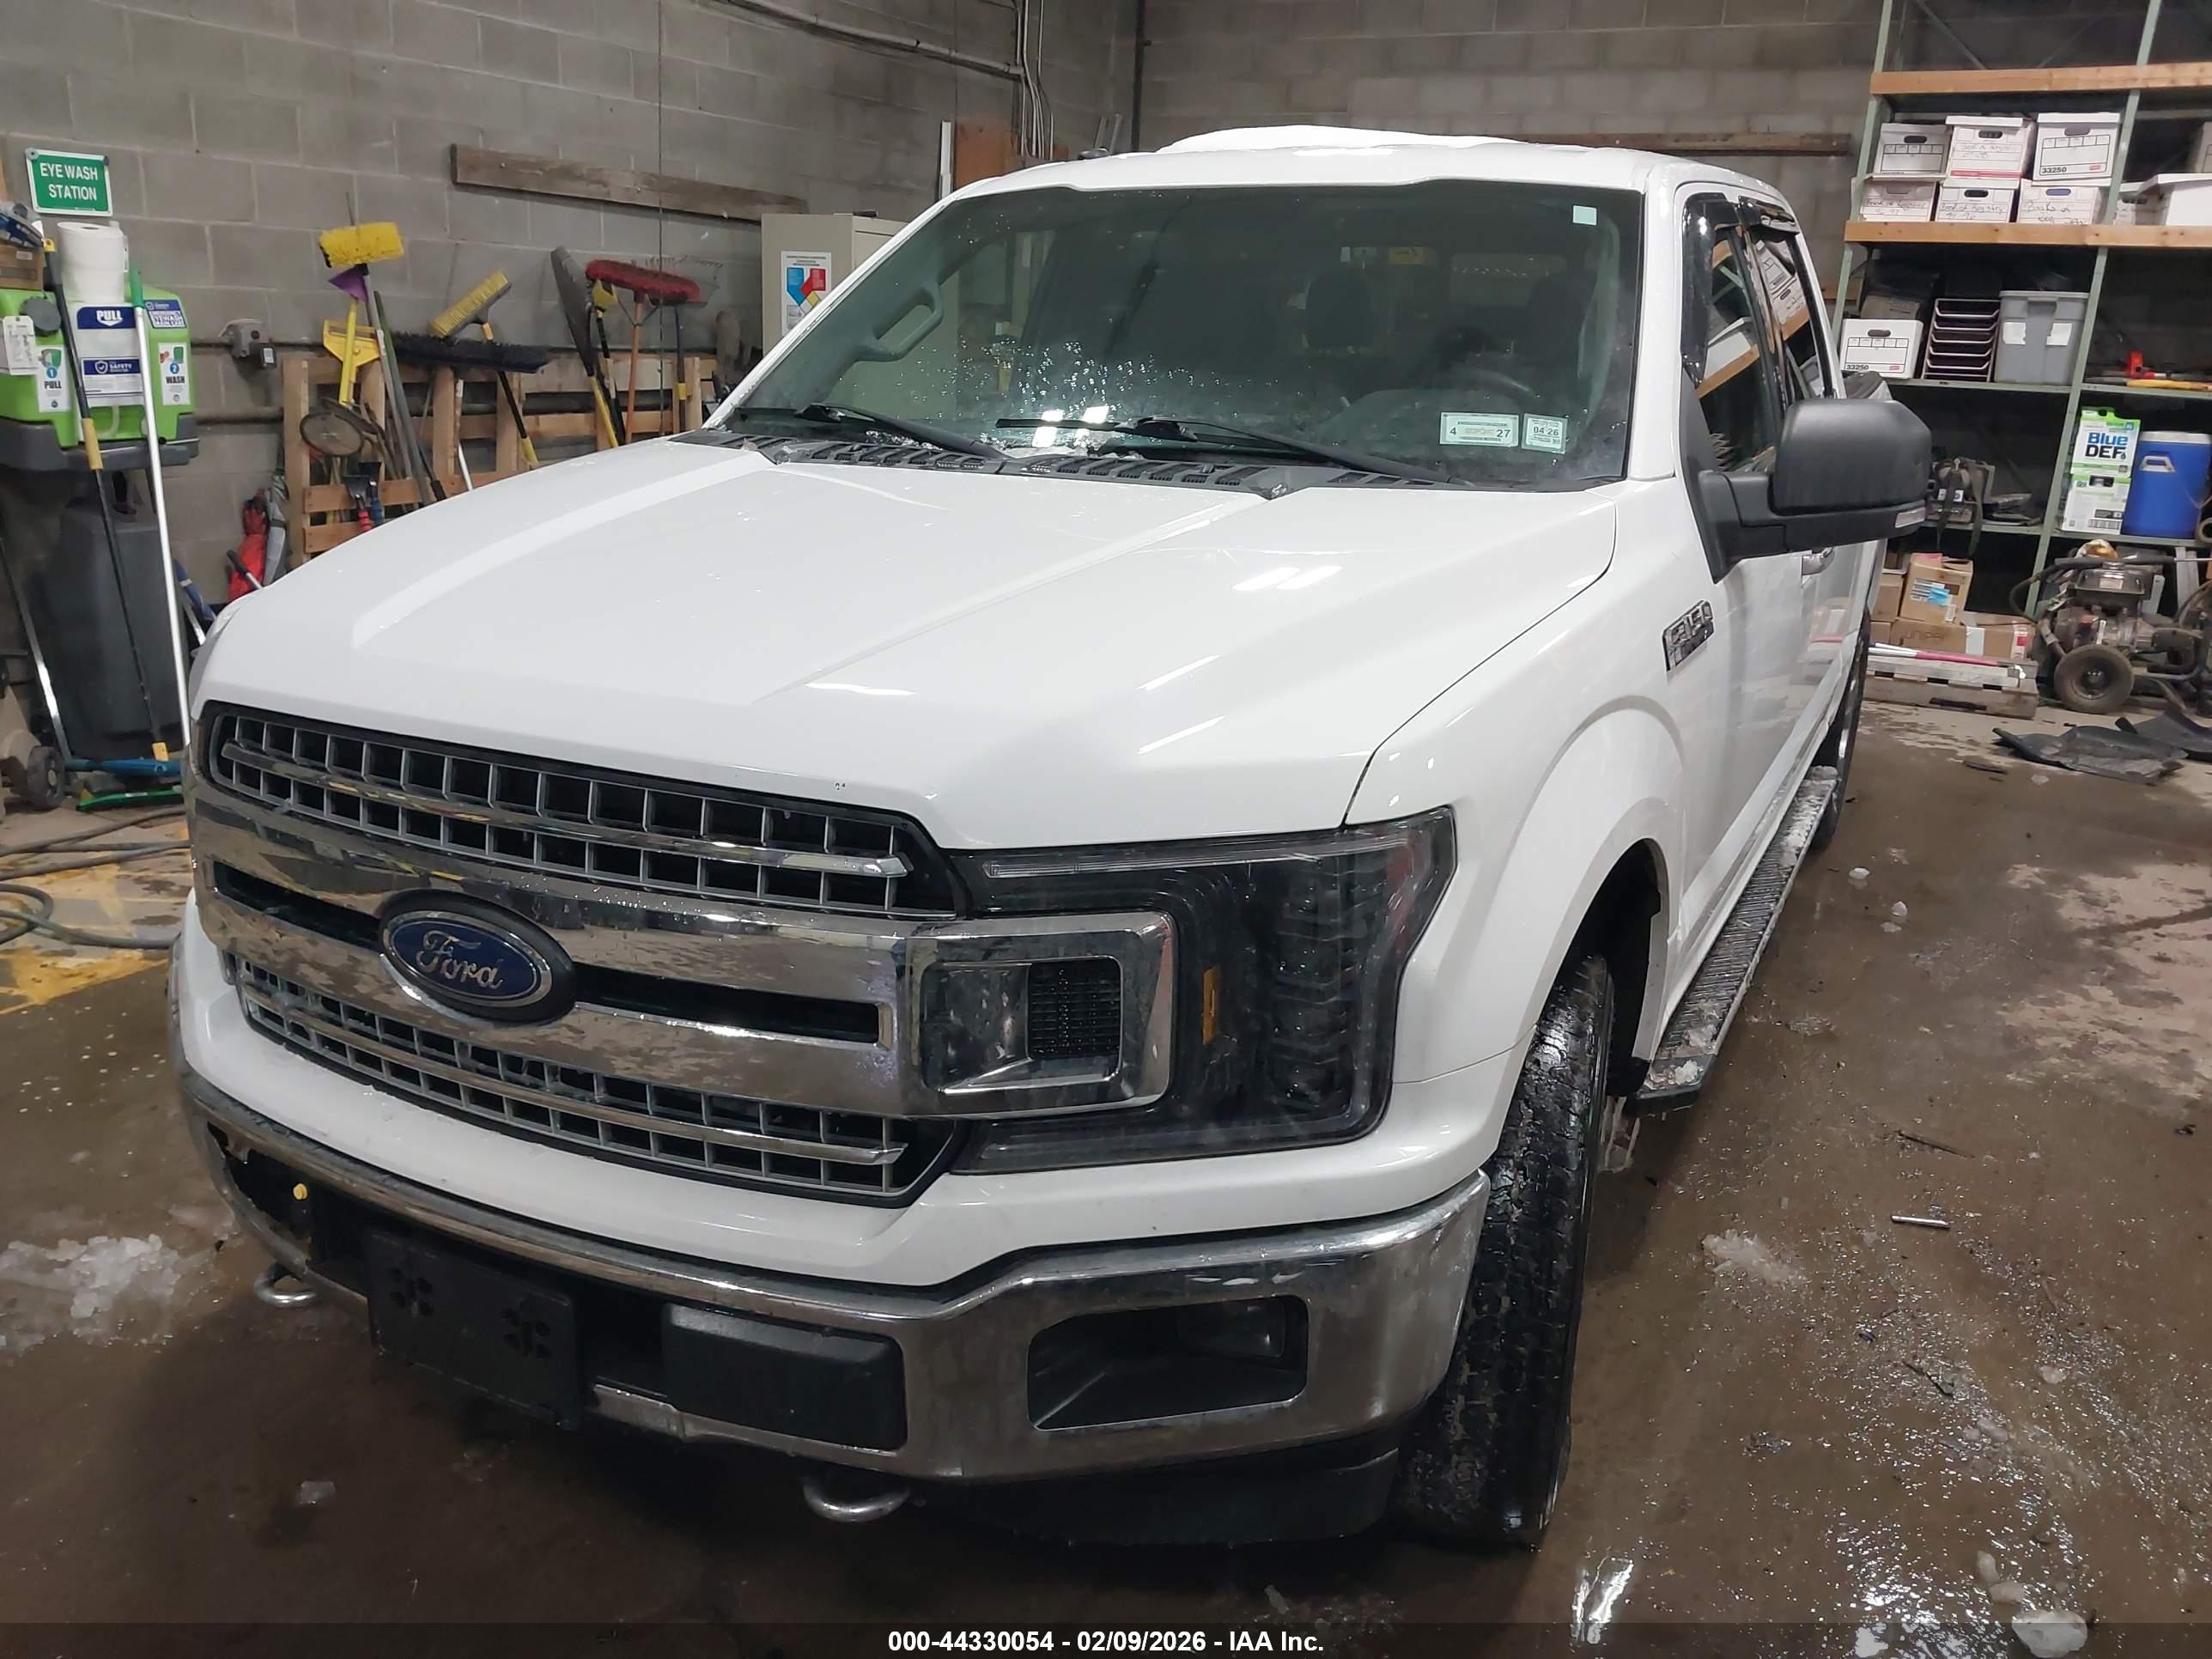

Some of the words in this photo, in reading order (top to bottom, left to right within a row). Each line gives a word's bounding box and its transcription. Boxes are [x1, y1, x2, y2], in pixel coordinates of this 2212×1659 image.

[40, 162, 64, 178] EYE
[64, 165, 98, 180] WASH
[48, 184, 97, 201] STATION
[96, 310, 123, 321] PULL
[45, 380, 62, 389] PULL
[1449, 427, 1456, 435] 4
[1497, 429, 1510, 438] 27
[1533, 426, 1544, 434] 04
[1547, 427, 1559, 436] 26
[2087, 432, 2129, 446] Blue
[2085, 444, 2126, 459] DEF
[416, 930, 503, 989] Ford
